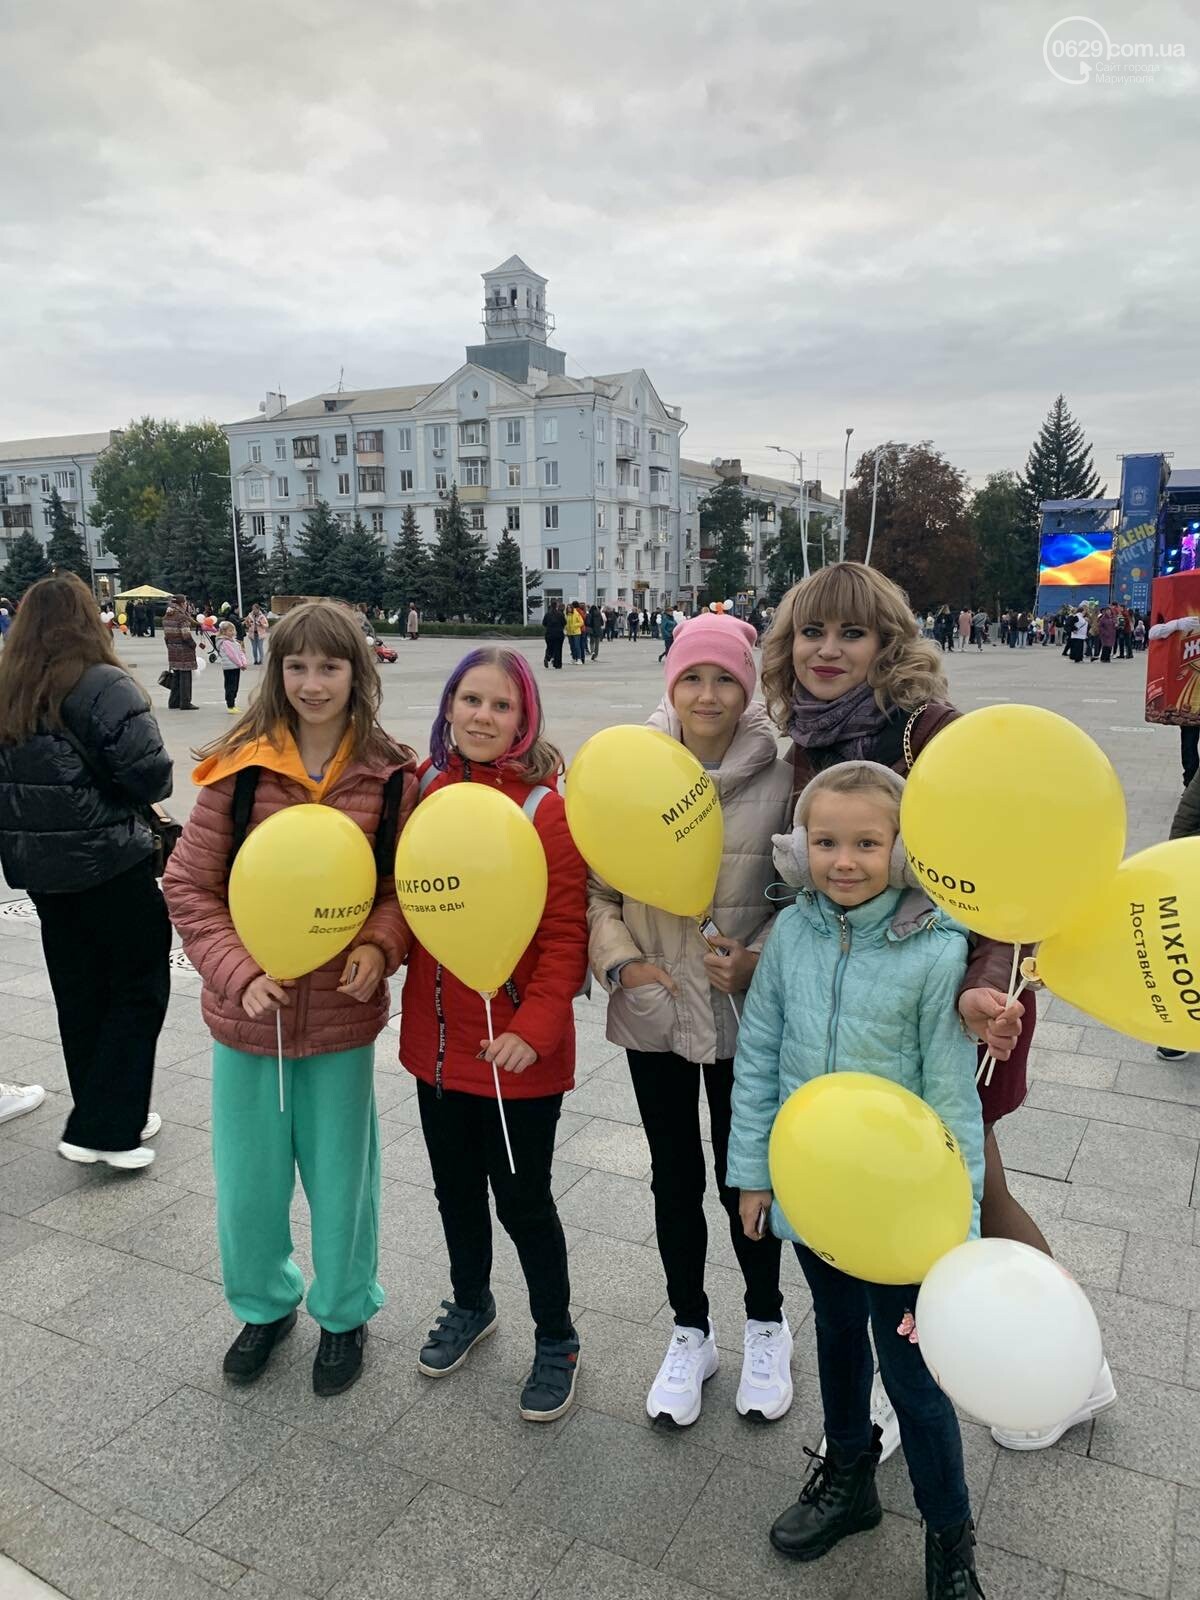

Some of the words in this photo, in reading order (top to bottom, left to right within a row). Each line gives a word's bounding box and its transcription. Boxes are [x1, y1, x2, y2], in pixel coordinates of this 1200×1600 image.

[1118, 523, 1156, 549] ДЕНЬ
[675, 803, 713, 842] Доставка
[401, 902, 437, 912] ставка
[439, 902, 465, 912] еды
[1129, 902, 1157, 990] Доставка
[1150, 993, 1173, 1023] еды
